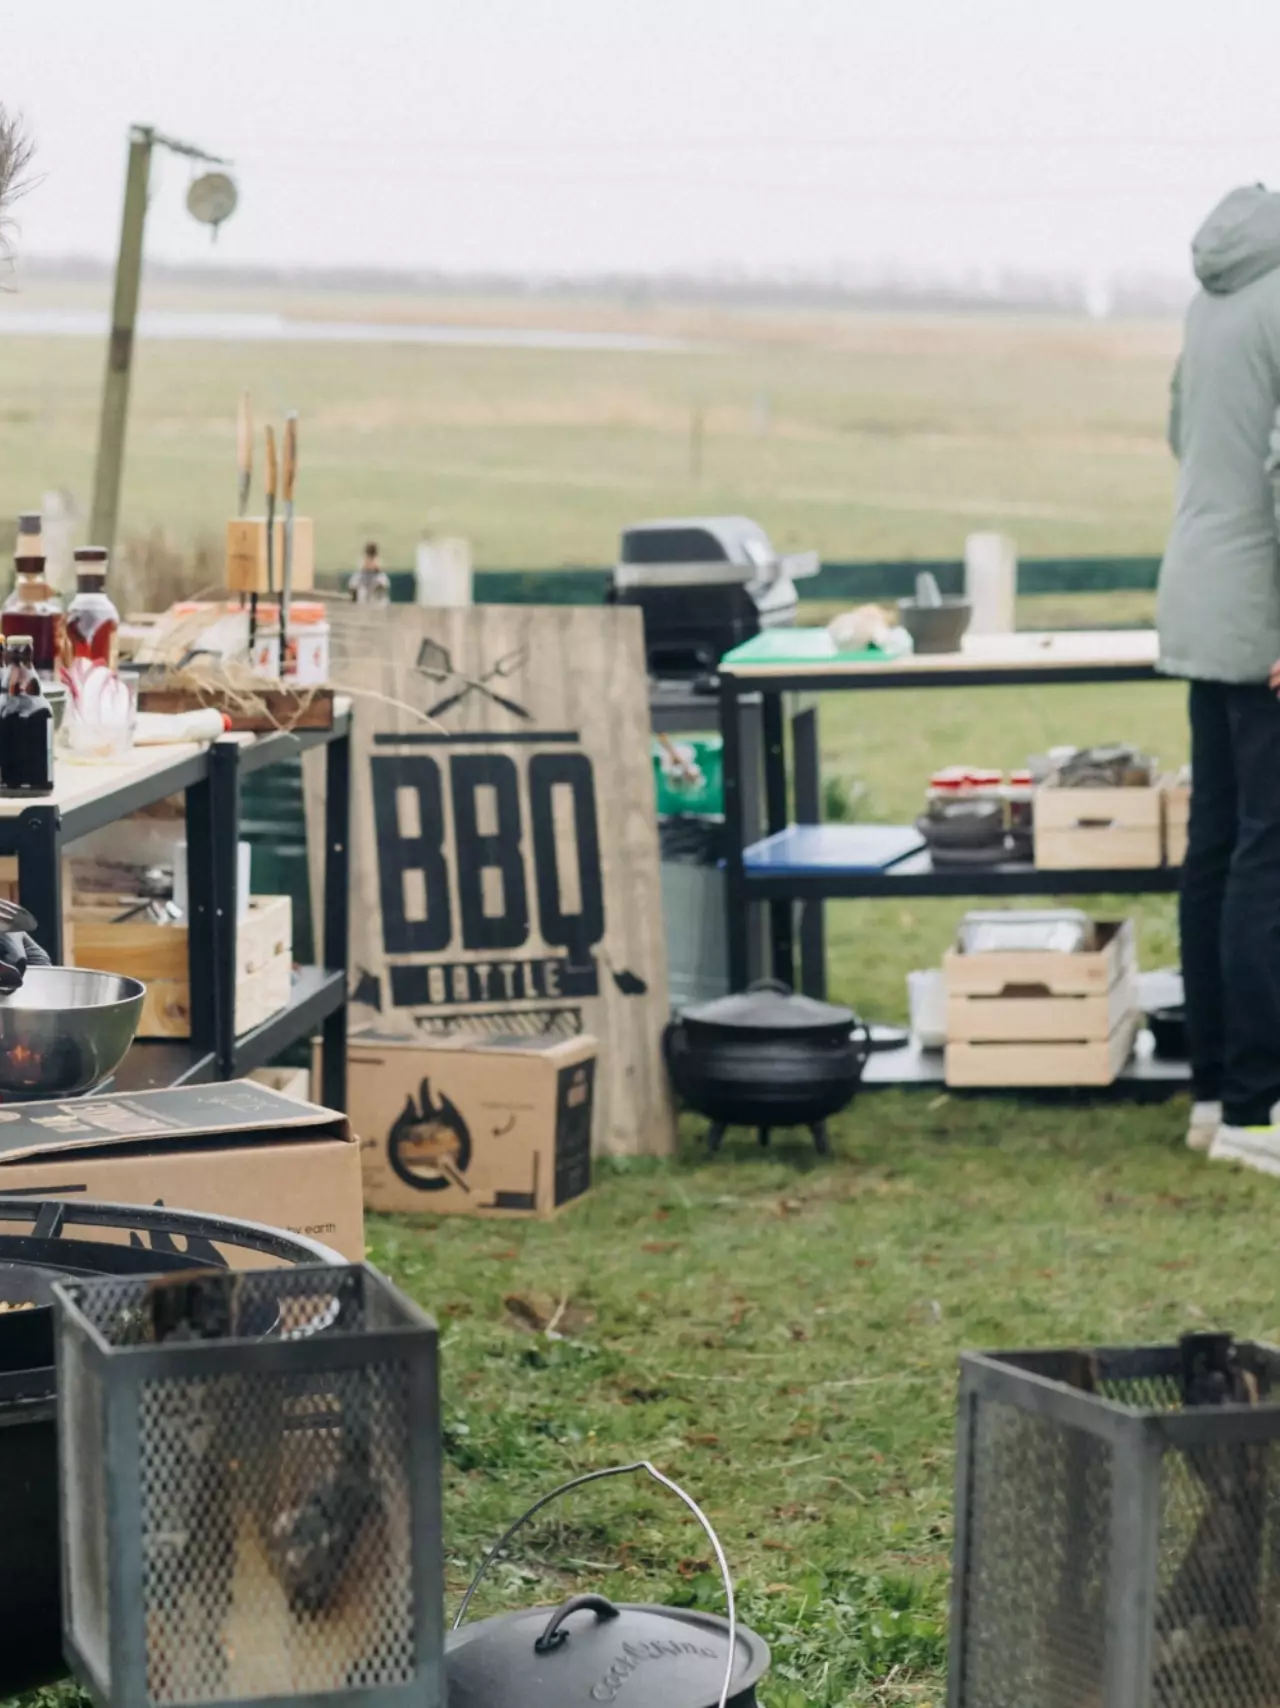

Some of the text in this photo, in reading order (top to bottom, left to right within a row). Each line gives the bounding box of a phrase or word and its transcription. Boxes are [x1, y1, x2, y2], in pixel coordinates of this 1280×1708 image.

[369, 752, 606, 972] BBQ
[427, 957, 562, 1004] BATTLE
[304, 1223, 336, 1235] earth
